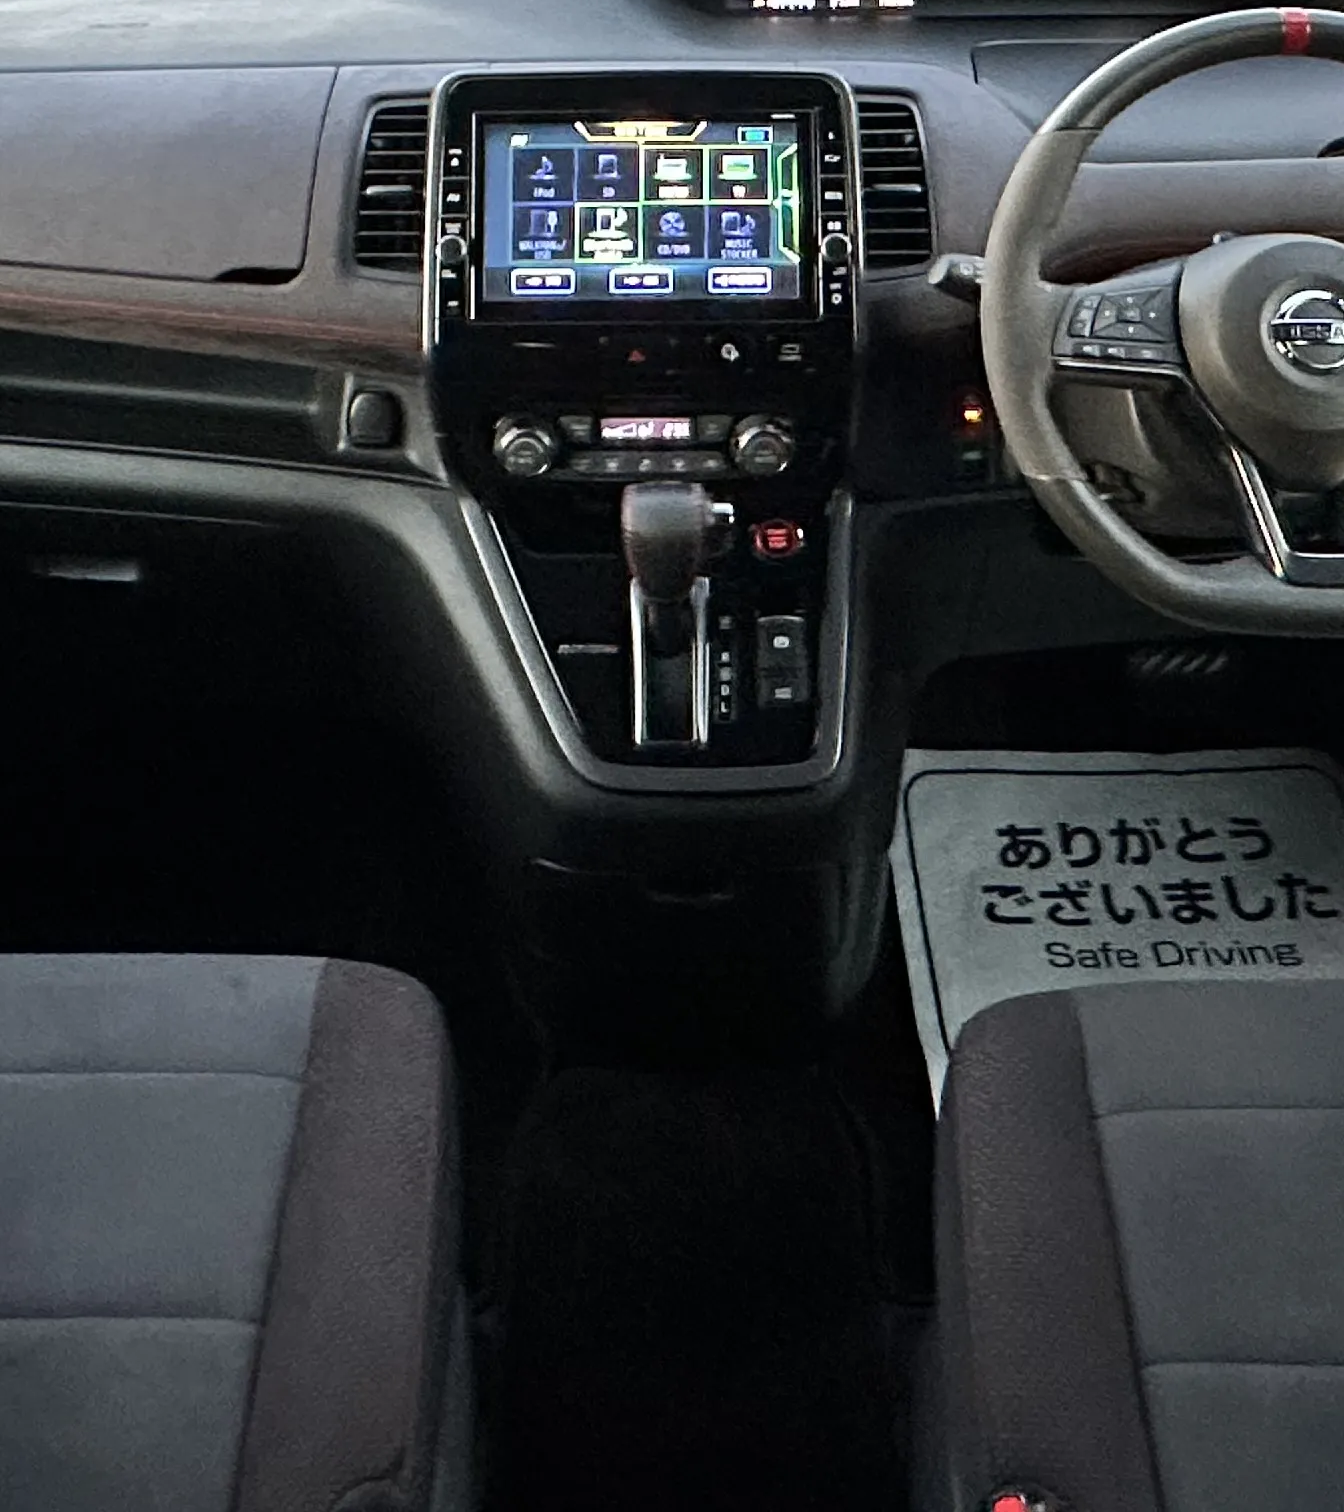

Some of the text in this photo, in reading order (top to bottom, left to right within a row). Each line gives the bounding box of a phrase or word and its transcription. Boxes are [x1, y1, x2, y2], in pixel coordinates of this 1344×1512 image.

[996, 817, 1274, 869] ありがとう
[981, 872, 1341, 926] ございました
[1045, 939, 1304, 969] Safe Driving
